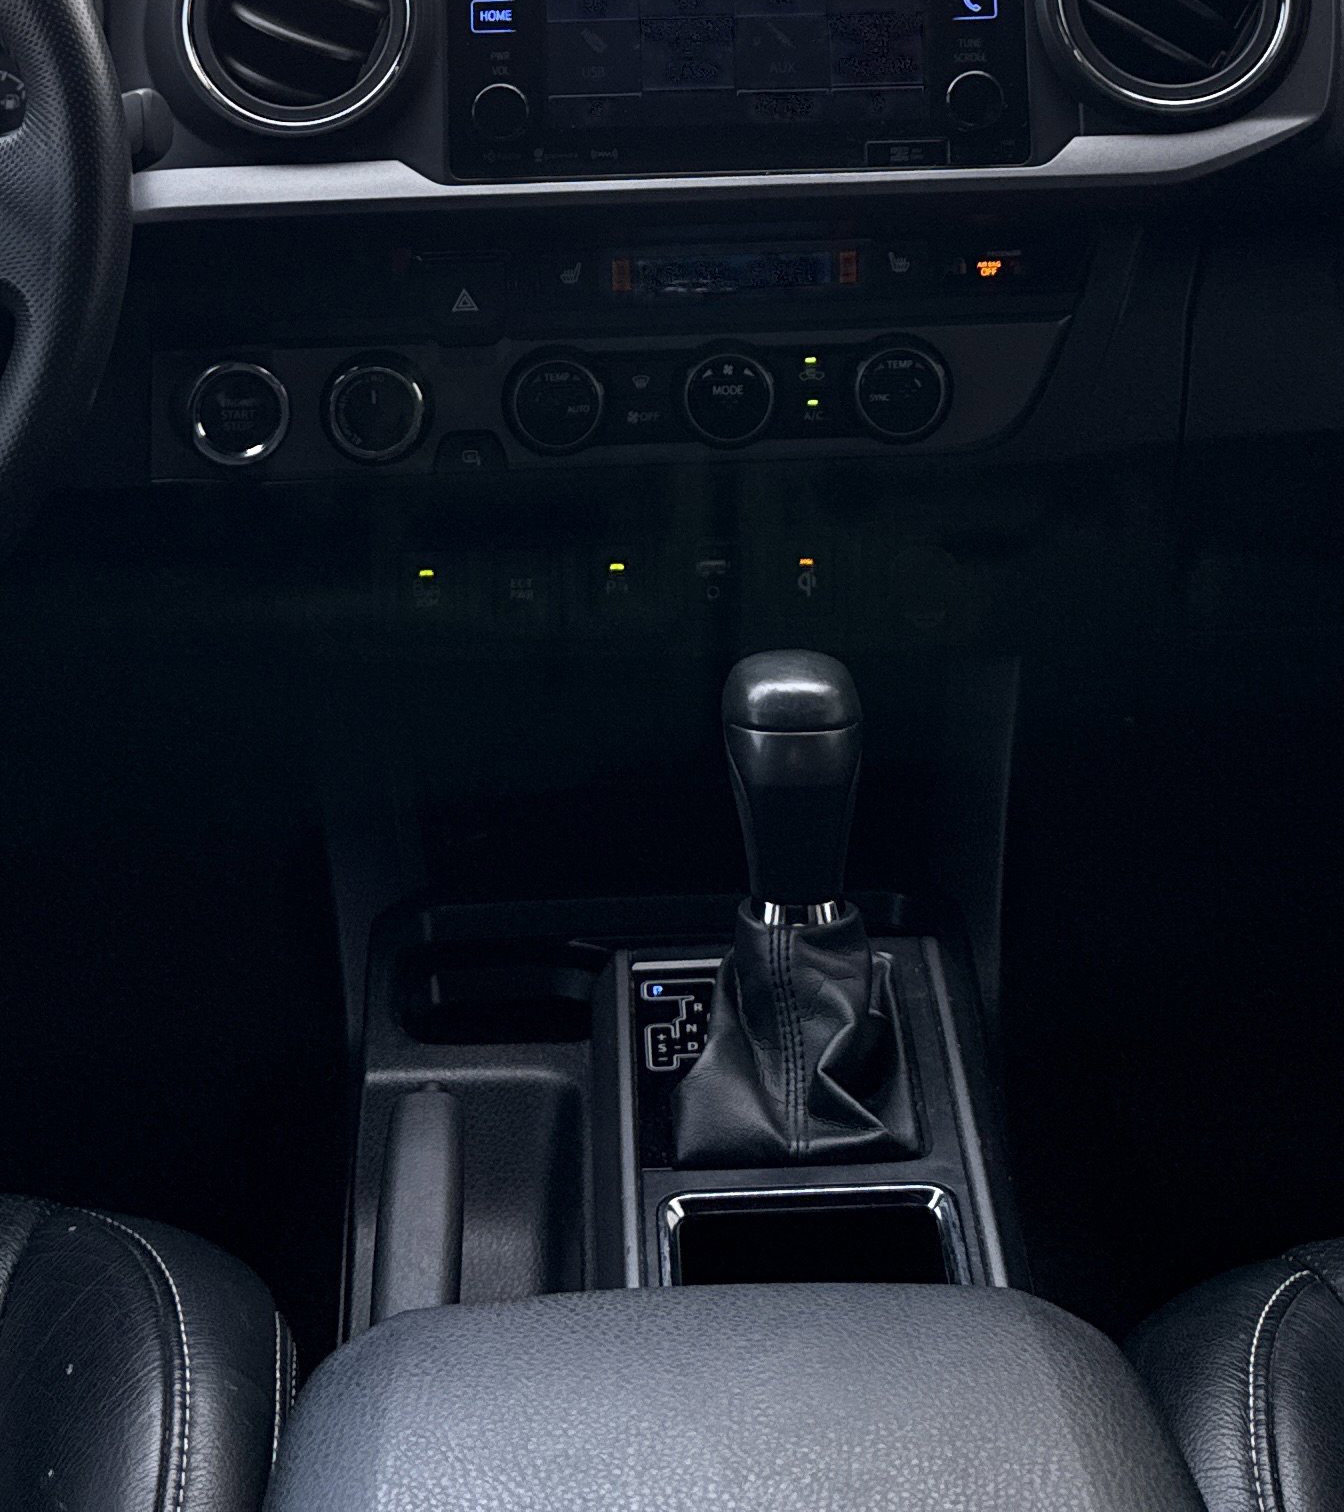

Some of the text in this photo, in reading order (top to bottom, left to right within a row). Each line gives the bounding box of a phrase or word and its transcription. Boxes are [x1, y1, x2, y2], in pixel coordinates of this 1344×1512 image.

[479, 8, 513, 23] HOME
[886, 359, 914, 370] TEMP
[712, 384, 744, 397] MODE
